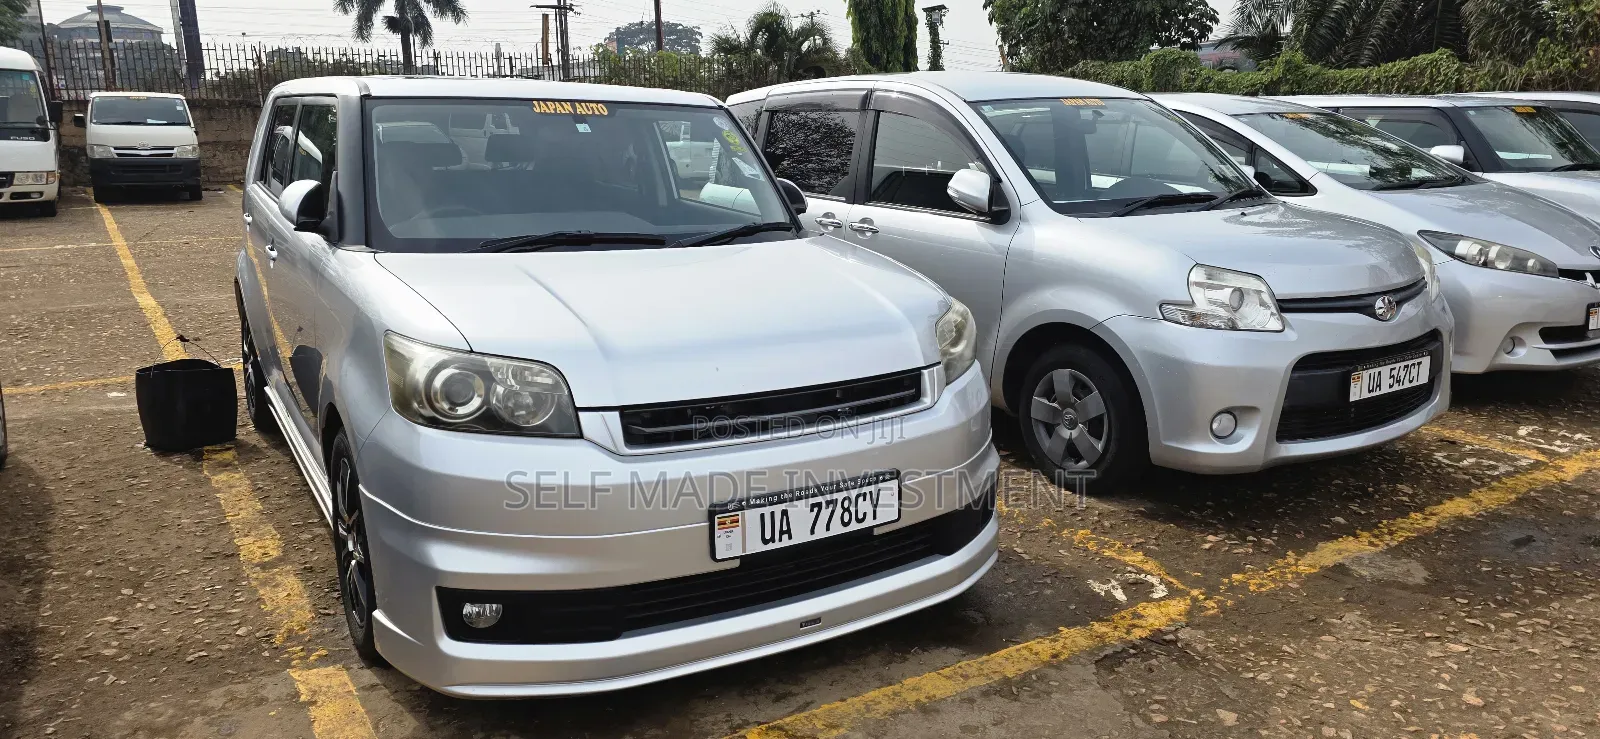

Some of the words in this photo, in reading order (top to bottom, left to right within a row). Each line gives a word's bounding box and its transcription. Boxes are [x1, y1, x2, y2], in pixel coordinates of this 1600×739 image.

[532, 101, 574, 114] JAPAN
[575, 102, 608, 115] AUTO
[1367, 370, 1382, 394] UA
[1388, 361, 1423, 389] 547CT
[749, 495, 778, 505] Making
[780, 492, 793, 500] the
[795, 487, 818, 498] Roads
[820, 483, 837, 492] Your
[839, 480, 855, 489] Safe
[857, 476, 877, 486] Space
[760, 508, 793, 545] UA
[809, 489, 881, 536] 778CY
